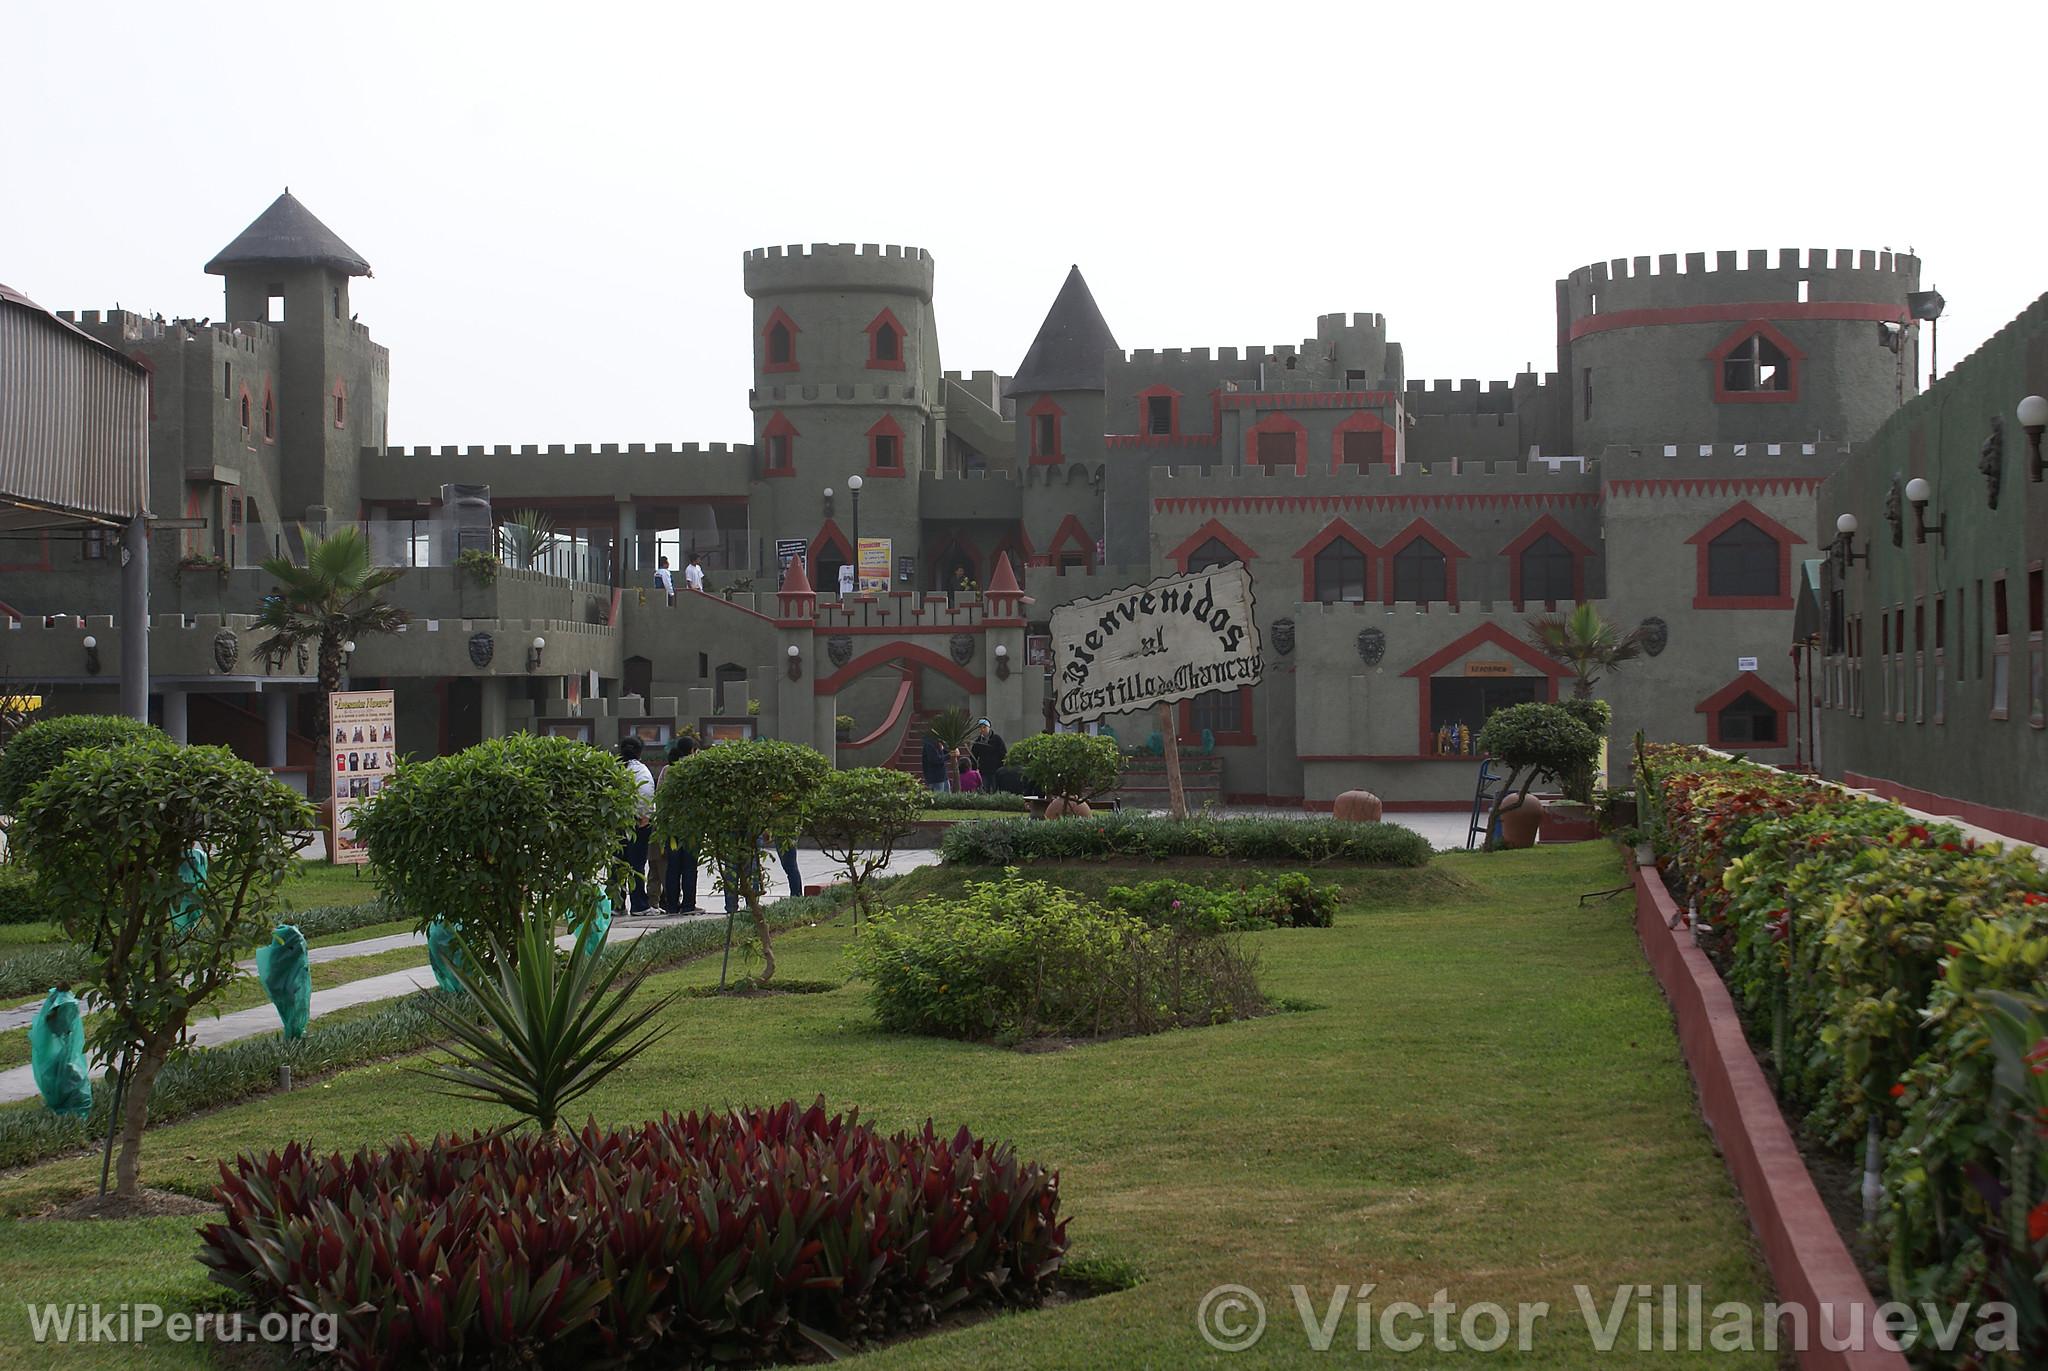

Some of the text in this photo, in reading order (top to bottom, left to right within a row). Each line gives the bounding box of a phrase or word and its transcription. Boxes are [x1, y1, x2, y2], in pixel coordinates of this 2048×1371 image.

[1063, 577, 1244, 686] Bienvenidos
[1141, 625, 1168, 657] al
[1061, 672, 1156, 715] Castillo
[1173, 654, 1262, 692] Chancay
